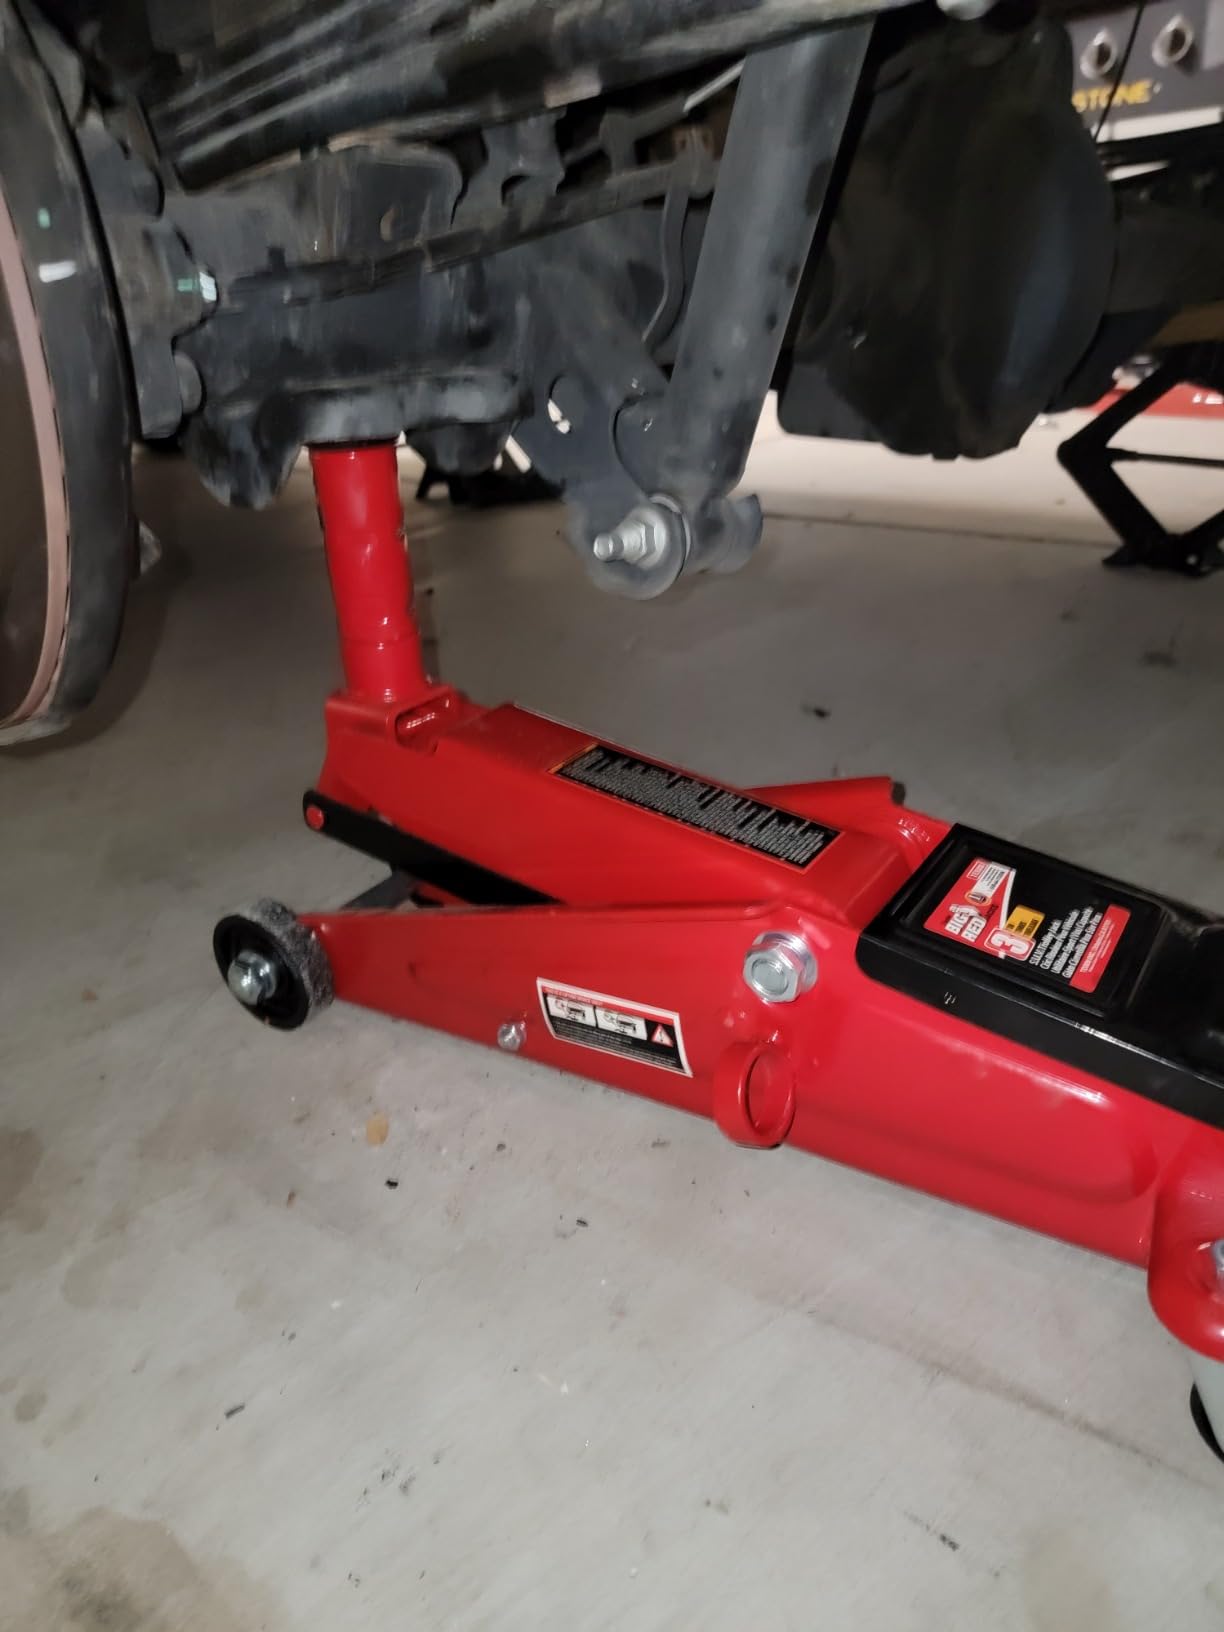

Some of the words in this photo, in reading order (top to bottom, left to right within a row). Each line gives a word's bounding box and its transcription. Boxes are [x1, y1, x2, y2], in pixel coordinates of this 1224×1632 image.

[945, 912, 969, 935] BIG
[961, 915, 987, 942] RED
[990, 934, 1030, 956] 3
